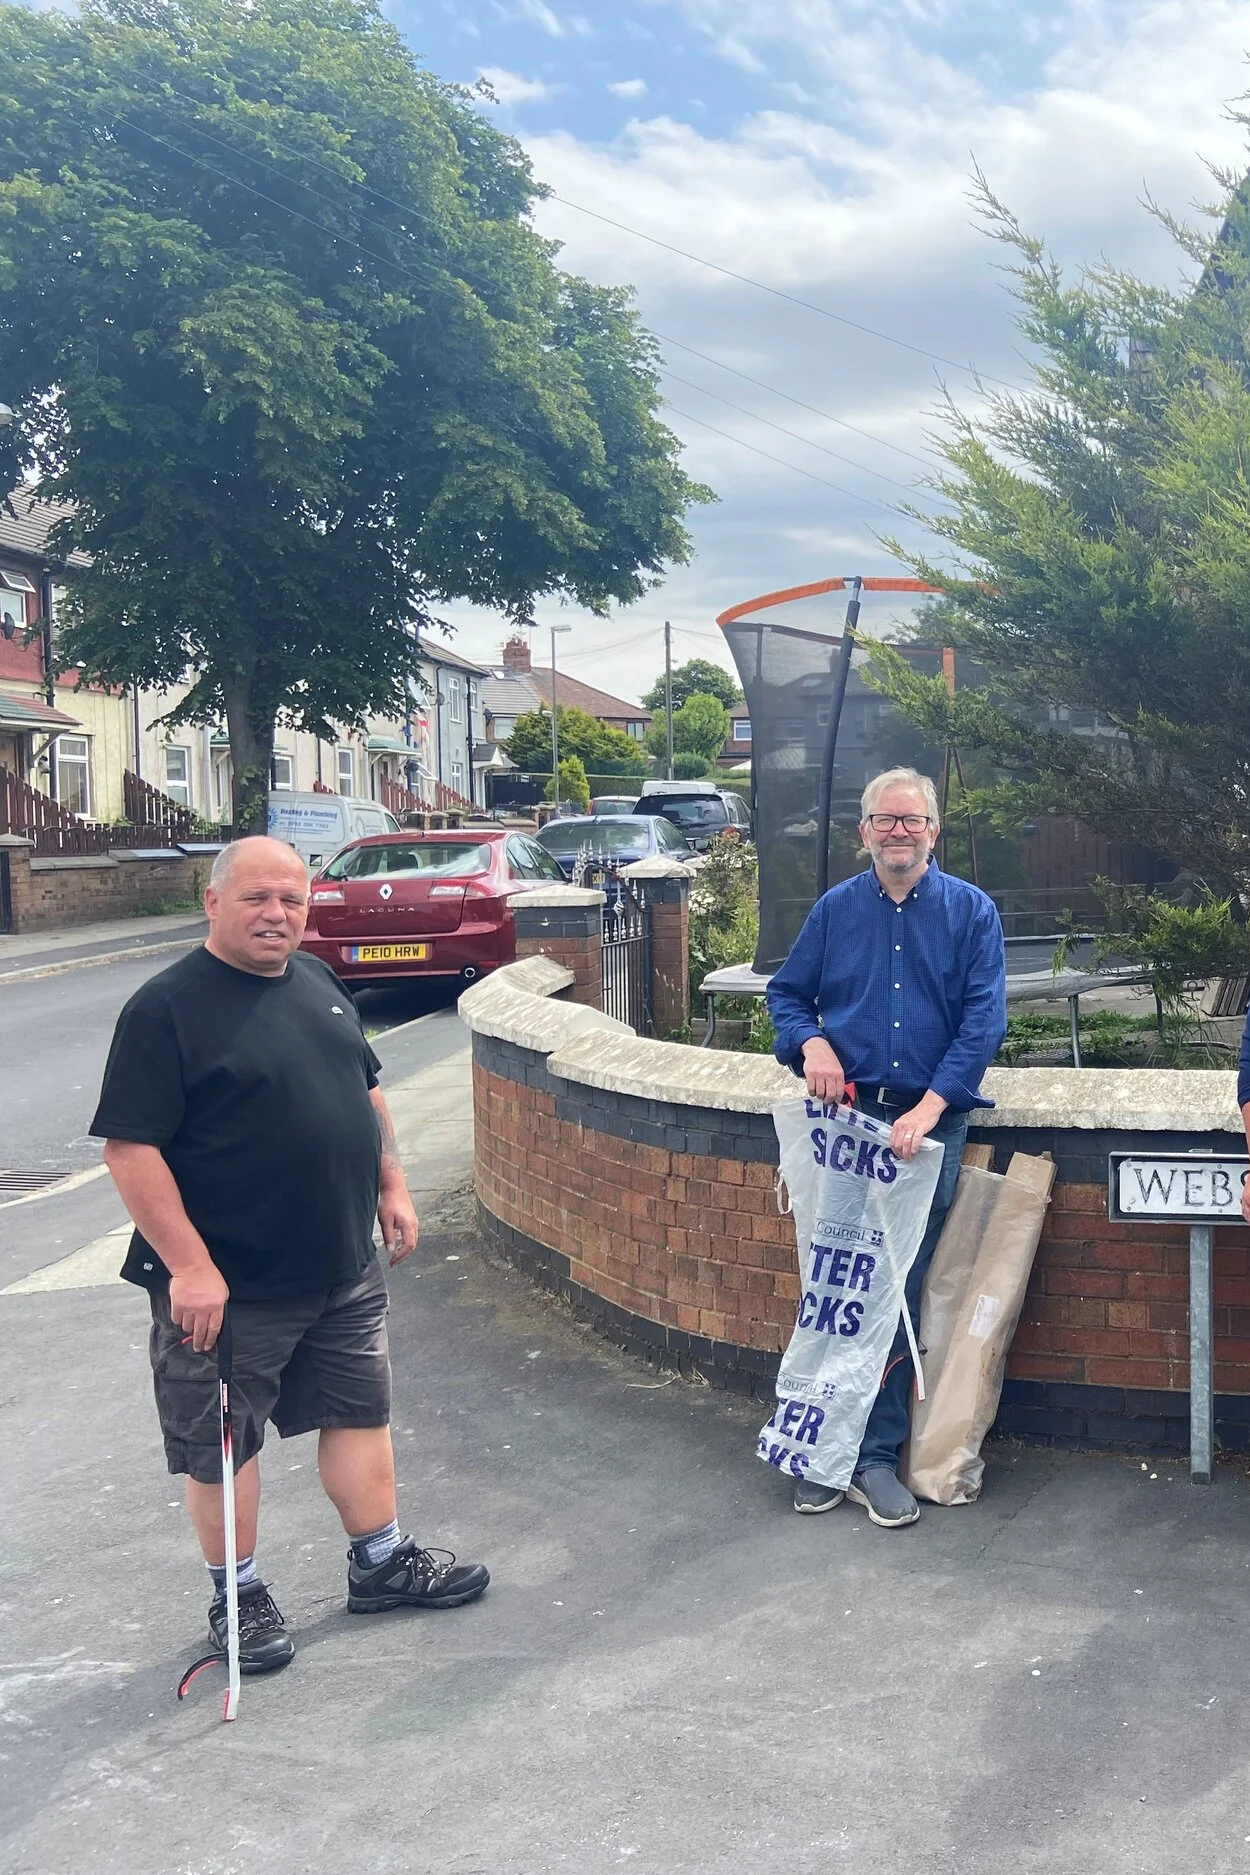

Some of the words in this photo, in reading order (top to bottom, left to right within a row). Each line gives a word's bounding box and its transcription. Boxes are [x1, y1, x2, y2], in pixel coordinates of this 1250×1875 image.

[362, 947, 391, 959] PE10
[394, 946, 420, 957] HRW
[816, 1220, 866, 1242] Council
[810, 1241, 876, 1293] TER
